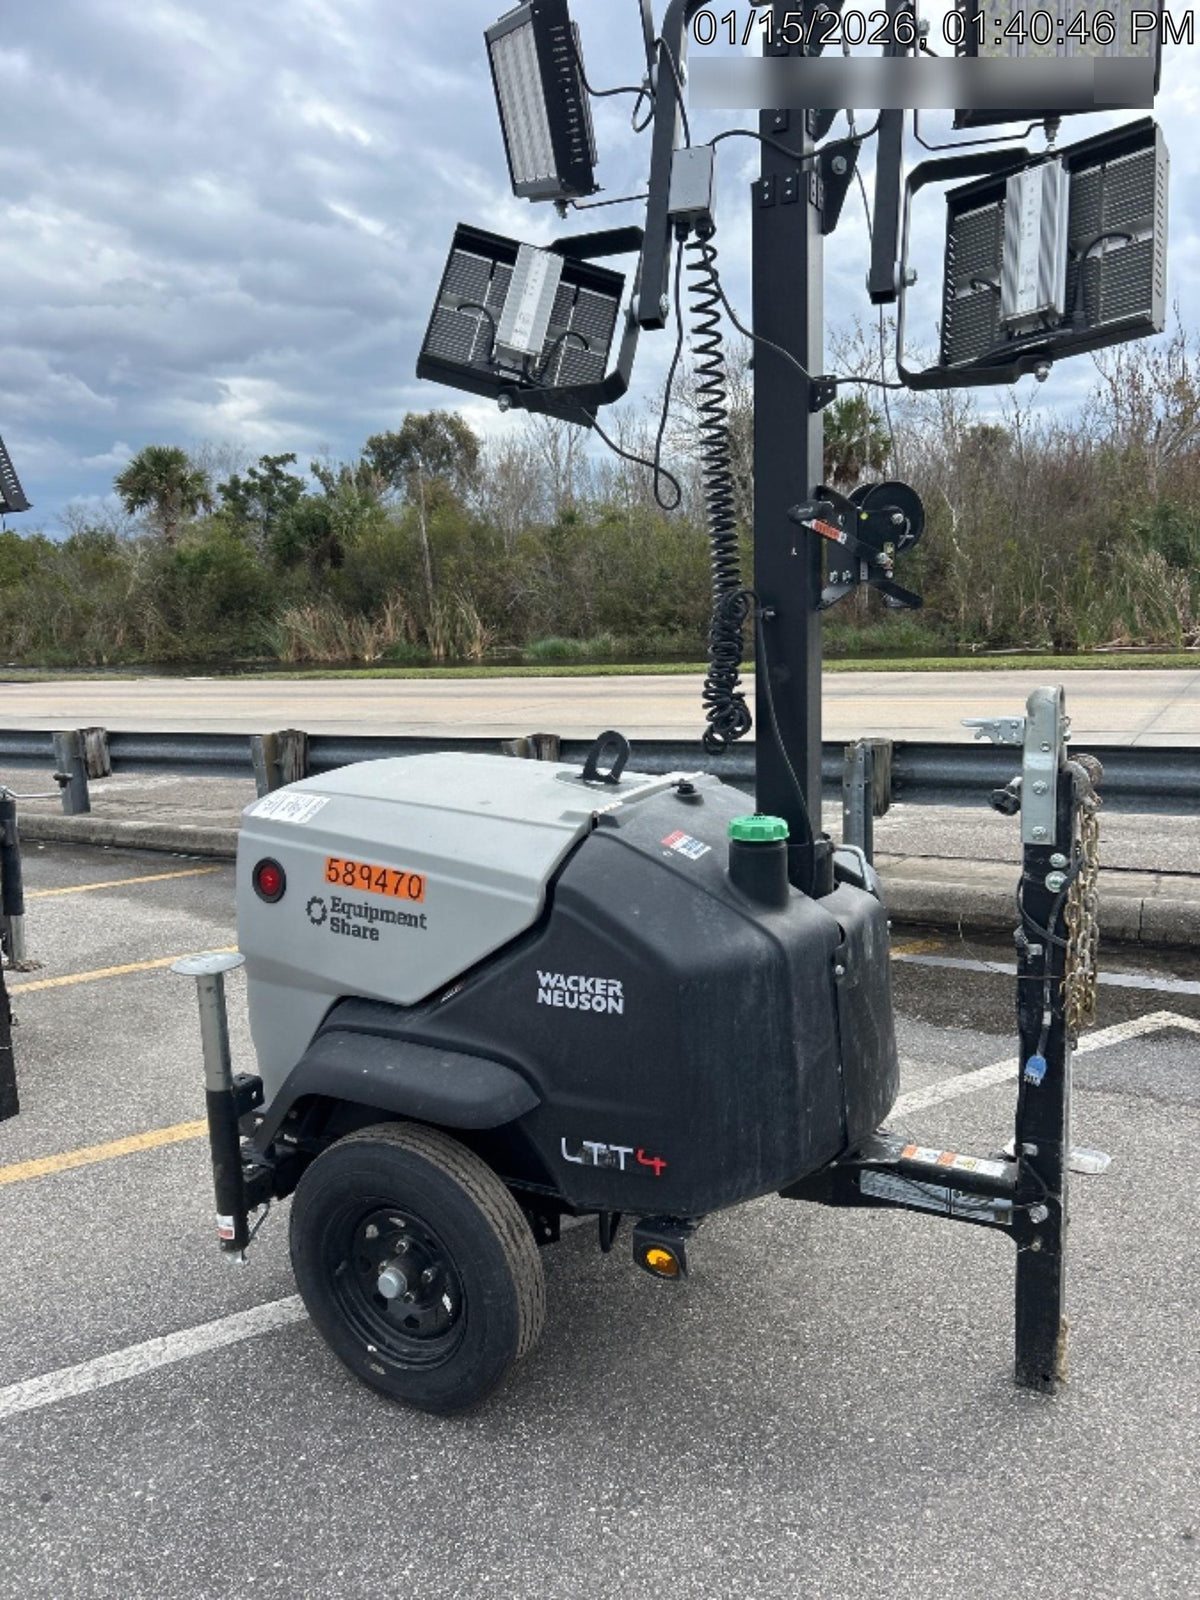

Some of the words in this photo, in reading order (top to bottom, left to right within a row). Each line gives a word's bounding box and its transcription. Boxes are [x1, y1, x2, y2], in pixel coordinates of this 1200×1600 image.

[326, 858, 422, 900] 589470
[330, 896, 427, 930] Equipment
[330, 917, 379, 941] Share
[536, 970, 625, 998] WACKER
[536, 988, 624, 1014] NEUSON
